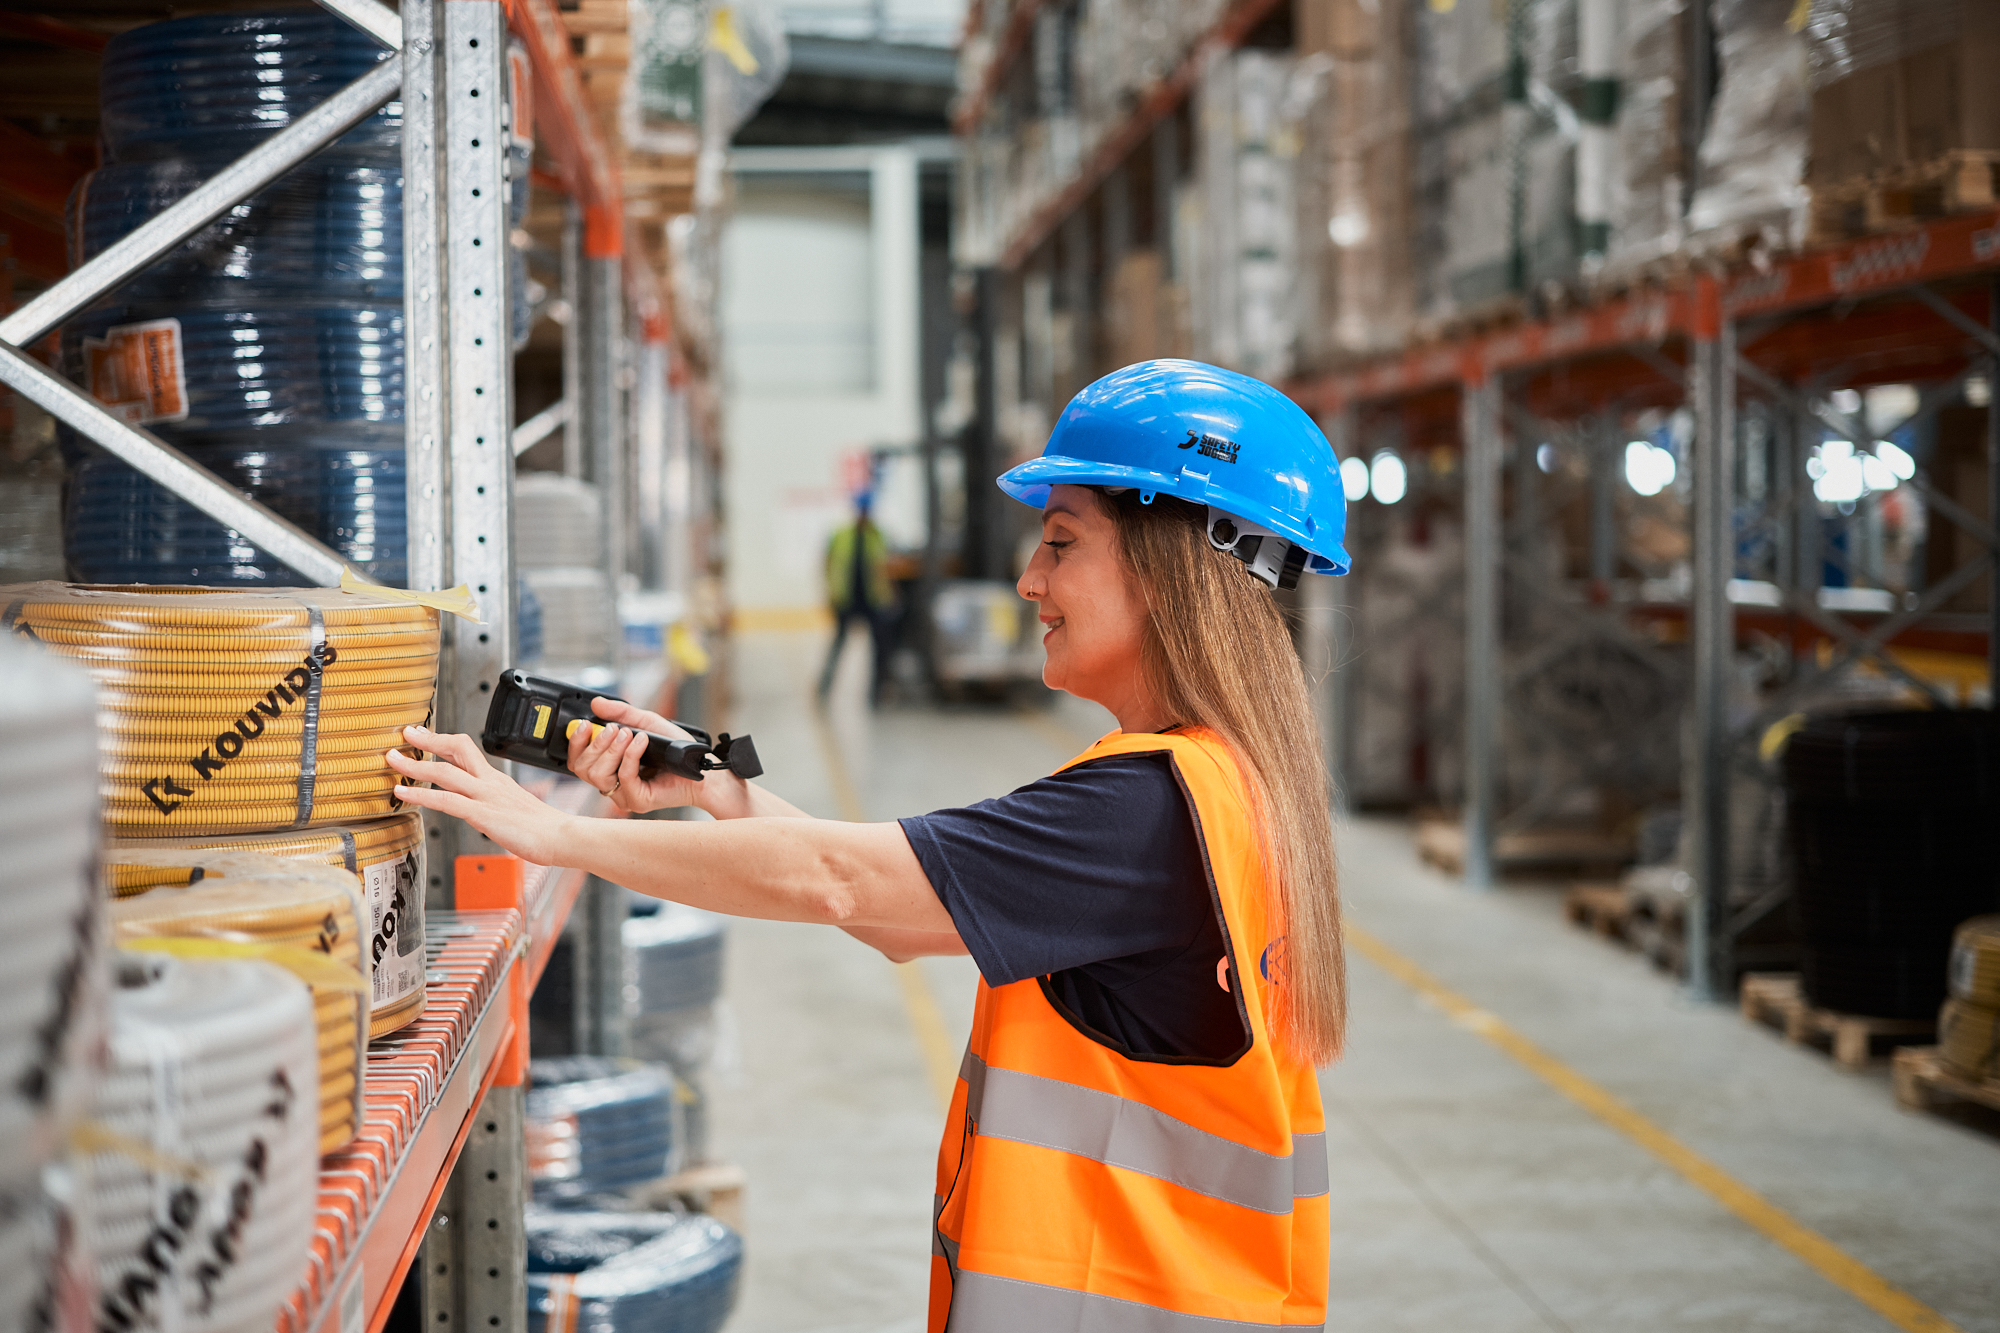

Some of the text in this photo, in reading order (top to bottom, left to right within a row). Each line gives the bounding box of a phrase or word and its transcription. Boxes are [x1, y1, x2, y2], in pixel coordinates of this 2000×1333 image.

[1201, 434, 1241, 453] SAFETY
[1197, 444, 1237, 464] JOGGER
[190, 640, 337, 781] KOUVIDIS
